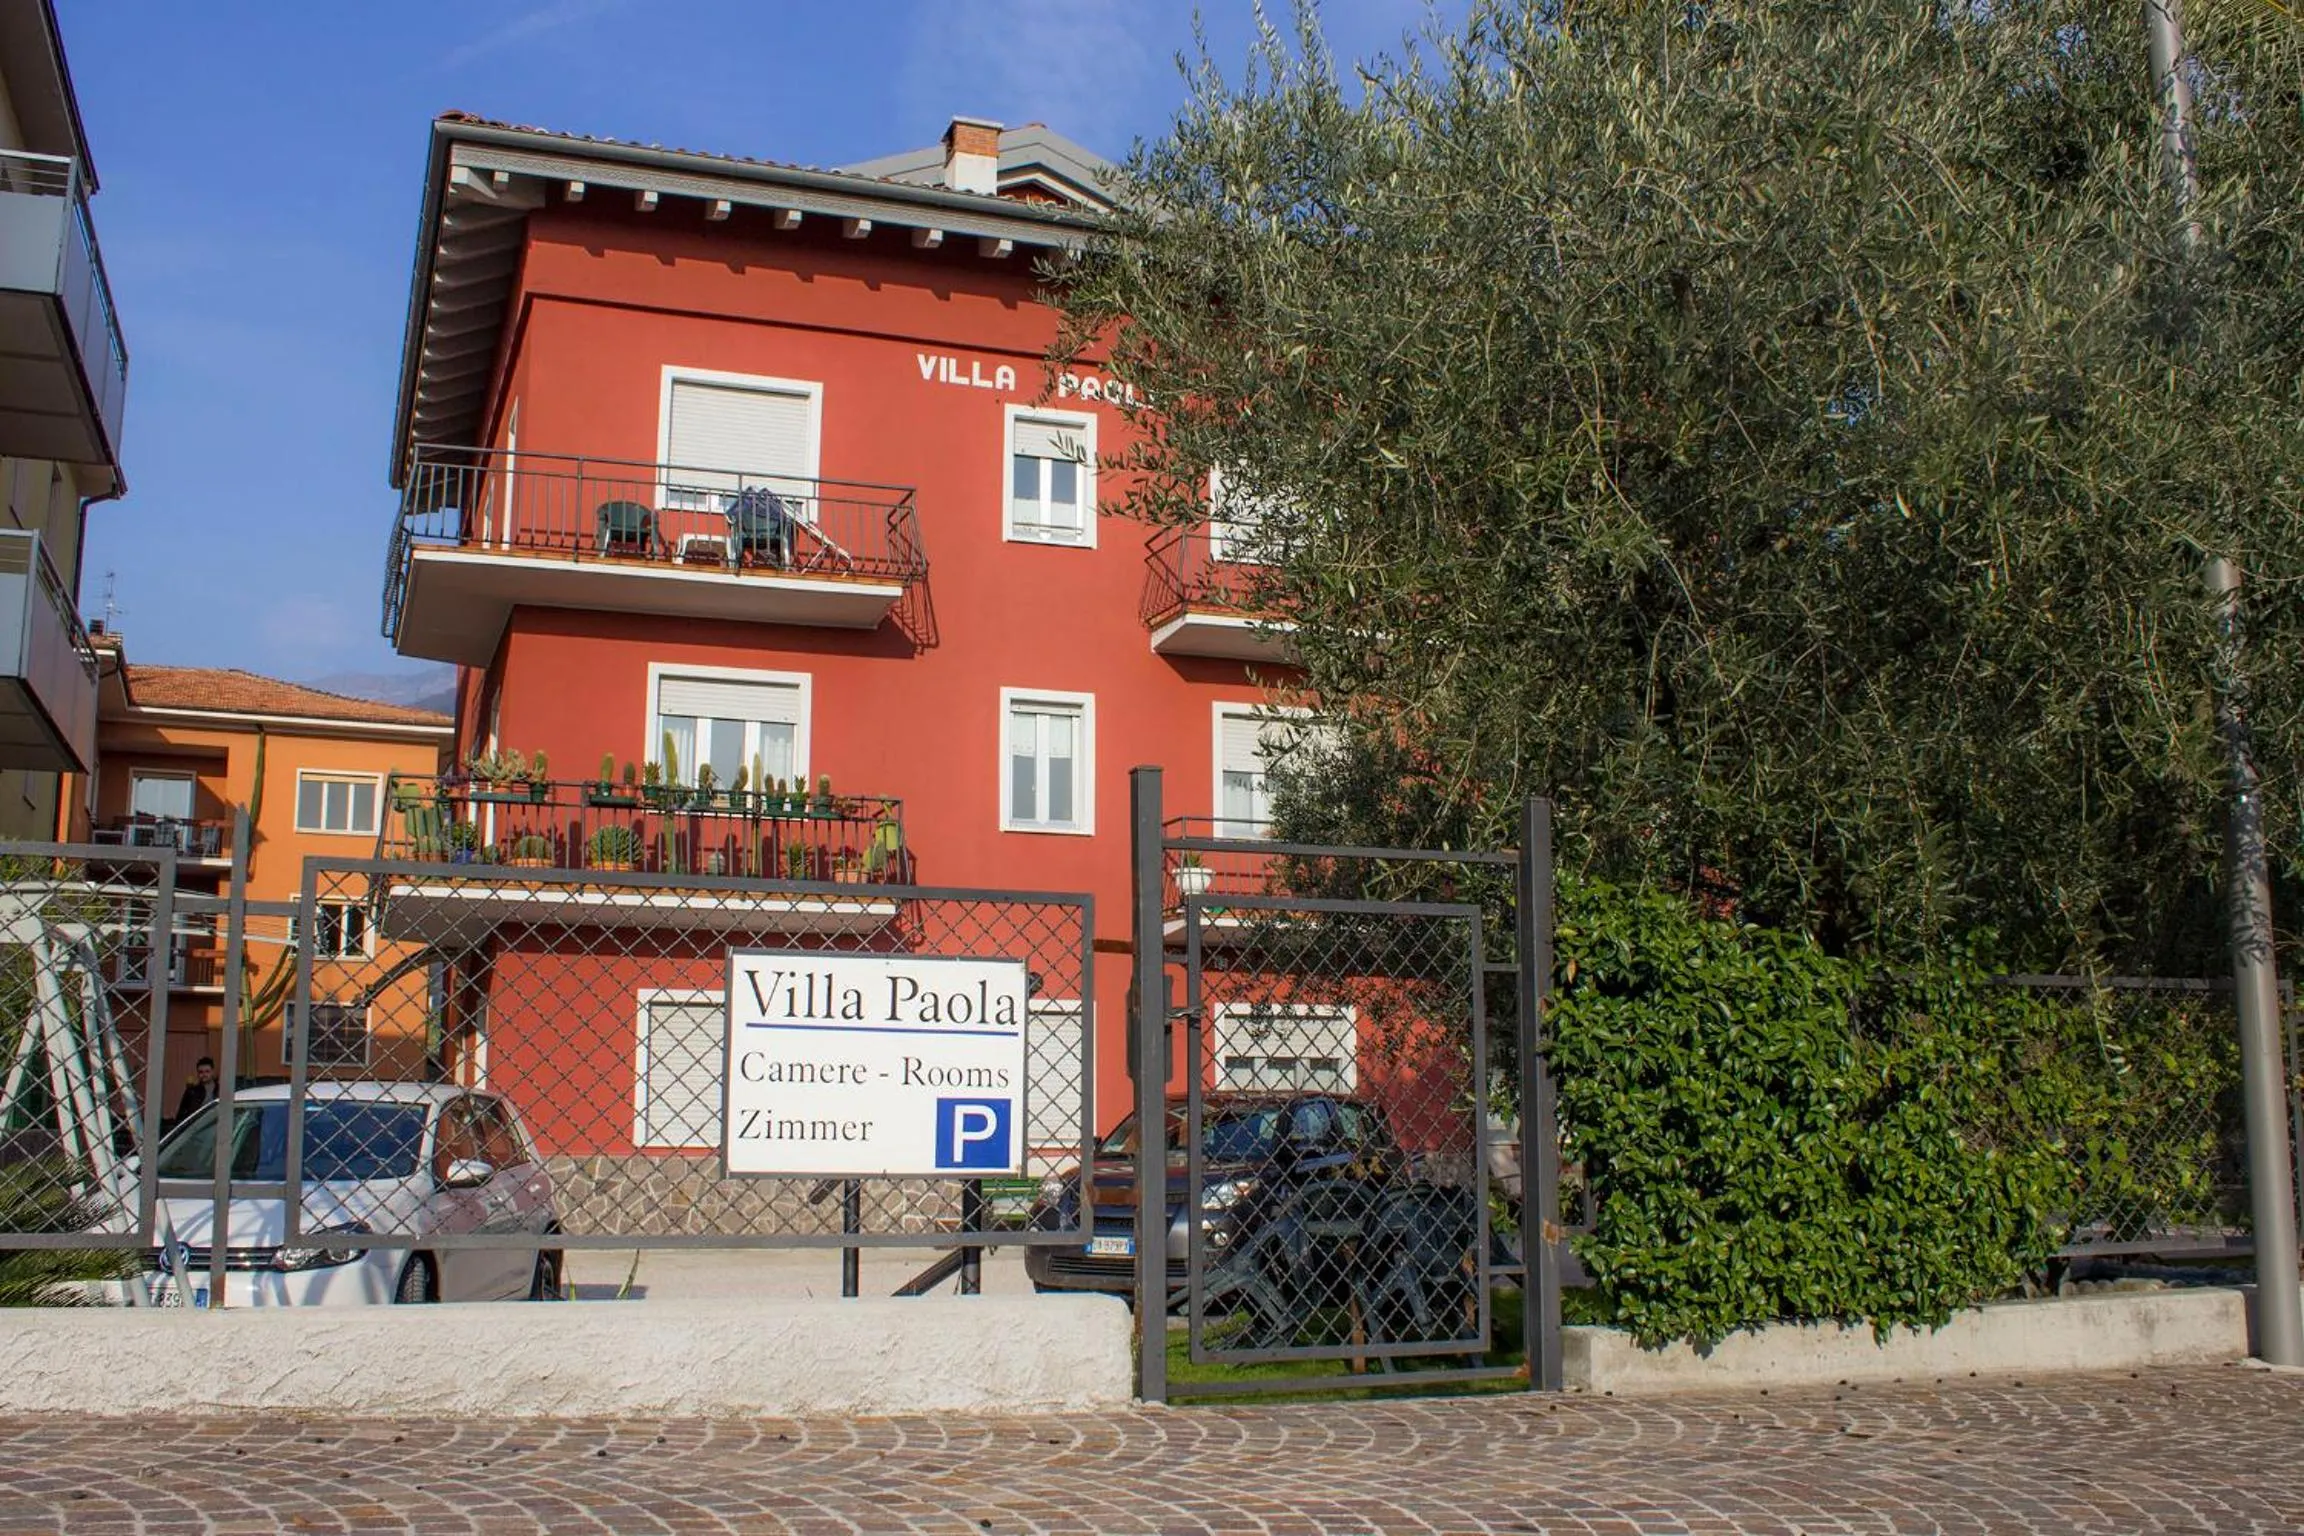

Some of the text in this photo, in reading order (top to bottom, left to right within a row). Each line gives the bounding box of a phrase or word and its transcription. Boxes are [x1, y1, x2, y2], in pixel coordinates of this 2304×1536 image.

[918, 354, 1154, 409] VILLA PAOL
[744, 970, 1017, 1025] Villa Paola
[741, 1053, 866, 1084] Camere
[903, 1057, 1008, 1087] Rooms
[739, 1110, 873, 1140] Zimmer
[954, 1105, 996, 1162] P
